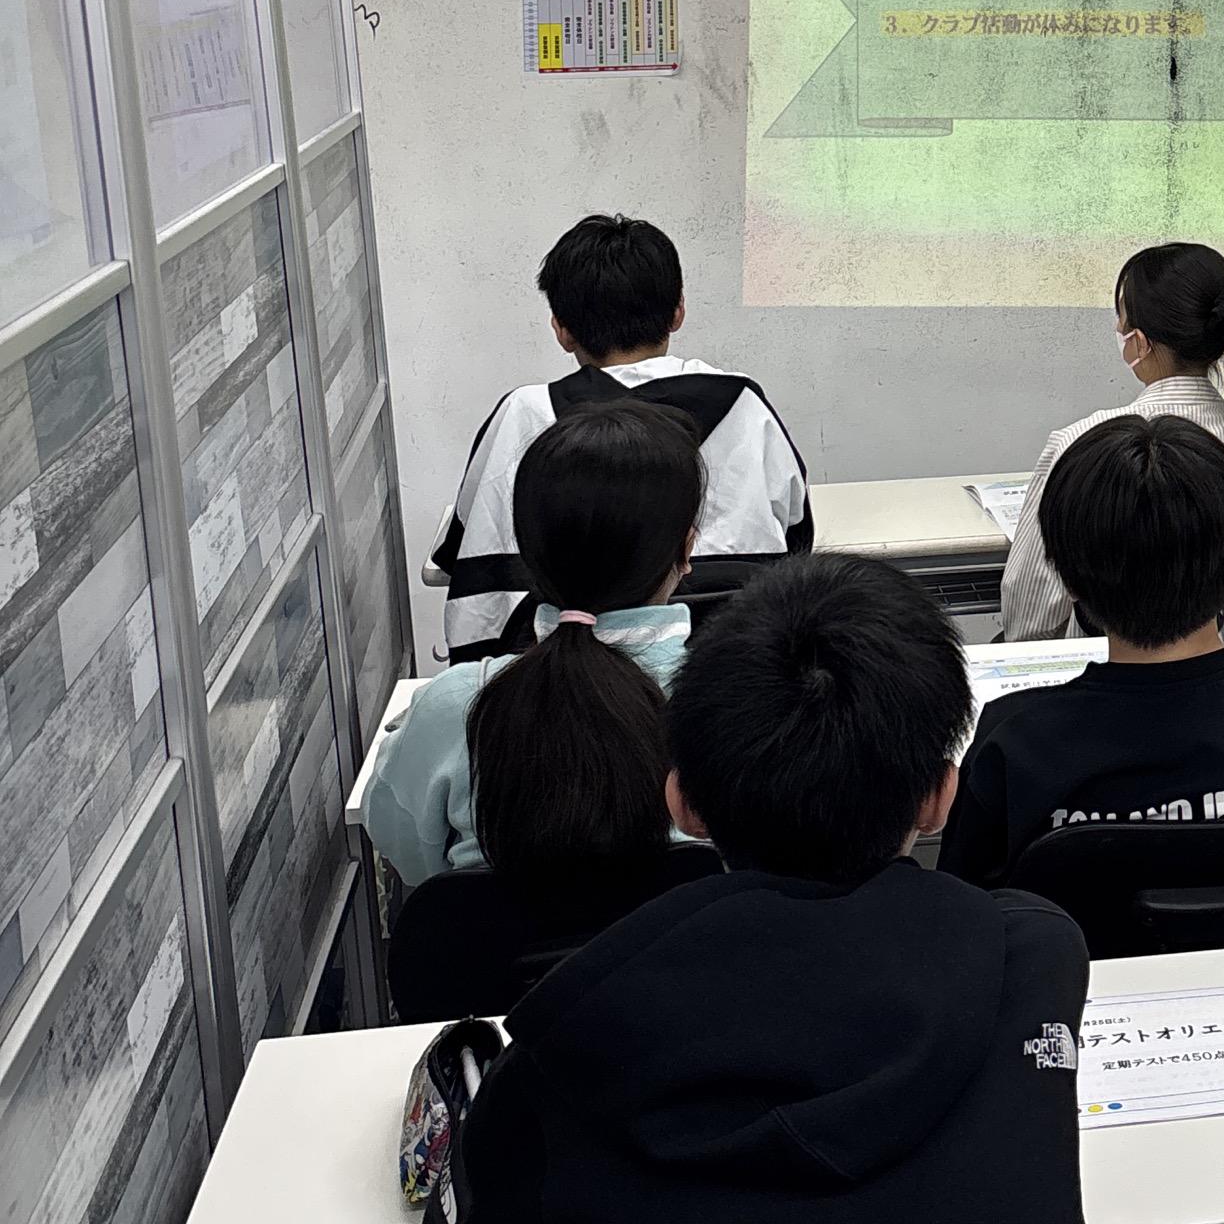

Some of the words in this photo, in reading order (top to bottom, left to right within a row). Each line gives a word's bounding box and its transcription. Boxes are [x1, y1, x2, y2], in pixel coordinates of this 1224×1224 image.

[1042, 1023, 1063, 1038] THE
[1023, 1038, 1064, 1055] NORTH
[1036, 1054, 1066, 1069] FACE
